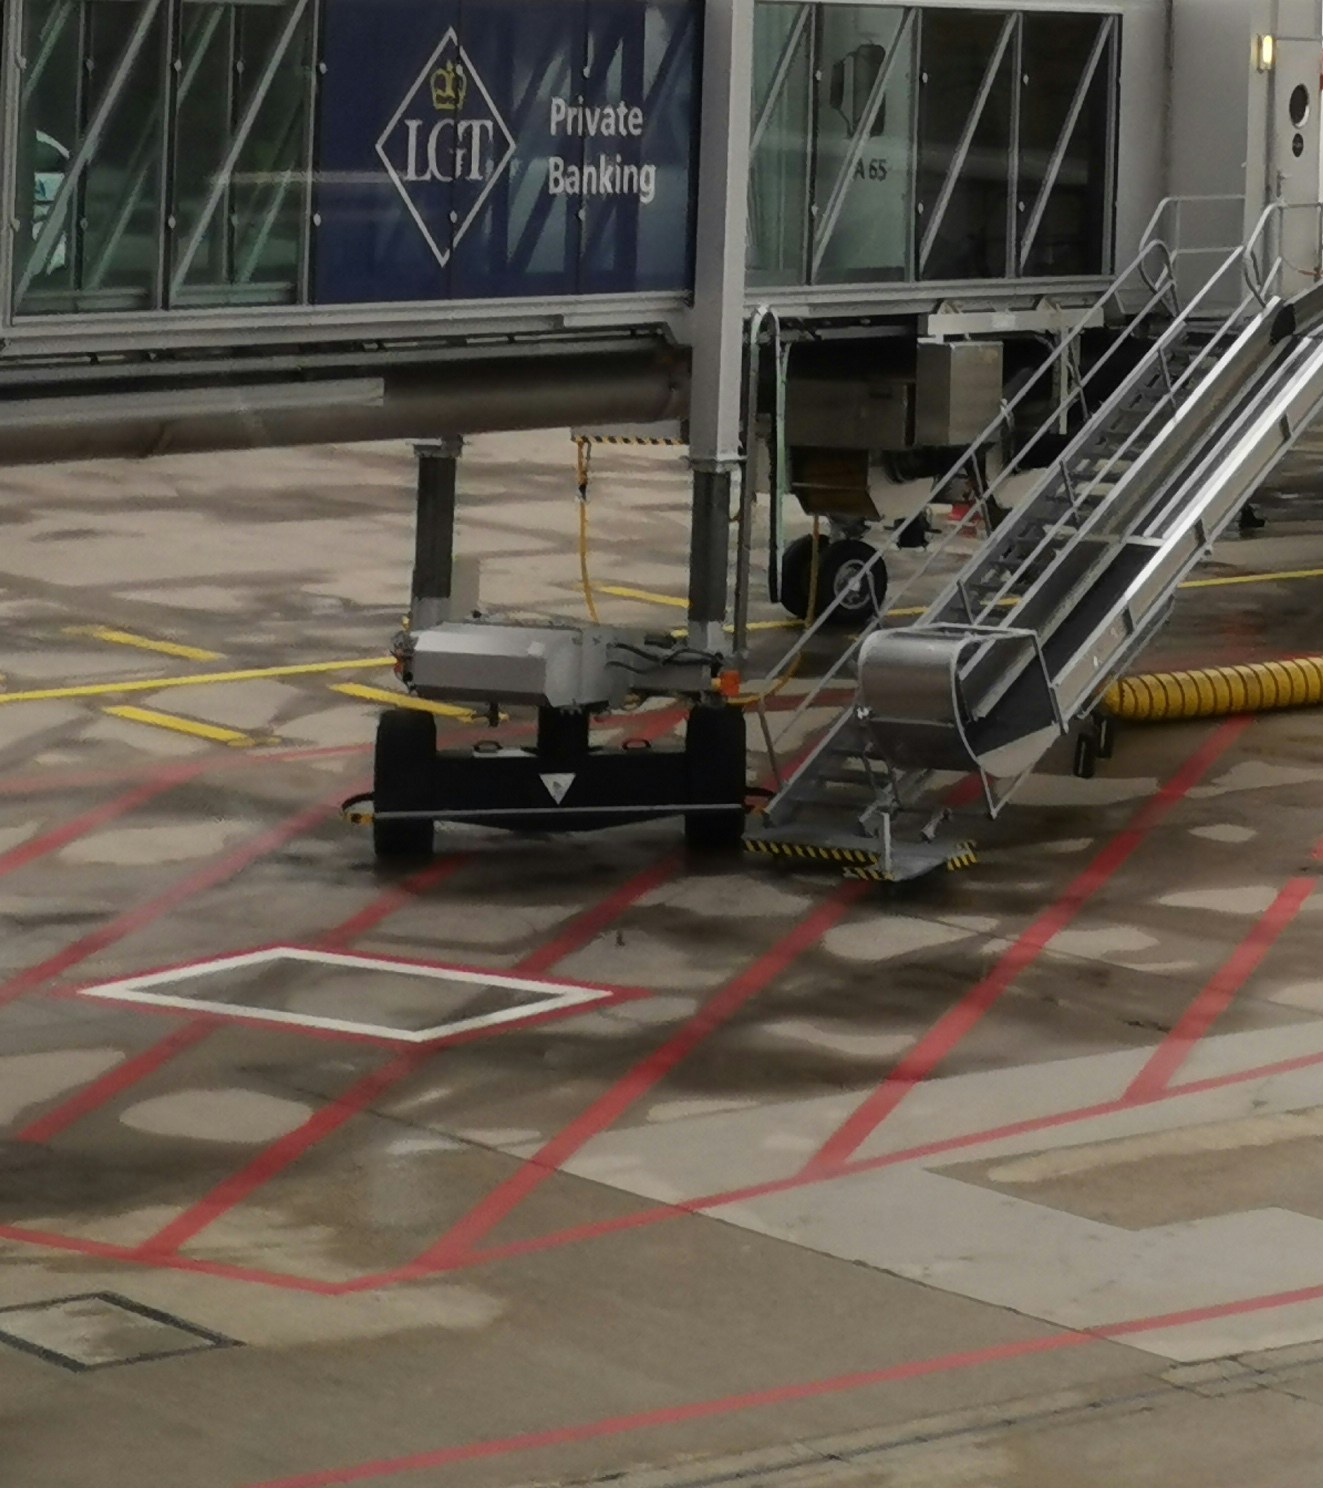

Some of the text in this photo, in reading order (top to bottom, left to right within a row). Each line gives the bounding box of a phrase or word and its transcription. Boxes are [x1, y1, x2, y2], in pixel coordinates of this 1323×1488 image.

[550, 95, 644, 137] Private
[404, 118, 494, 183] LGT
[853, 158, 888, 182] A 65
[548, 153, 657, 203] Banking
